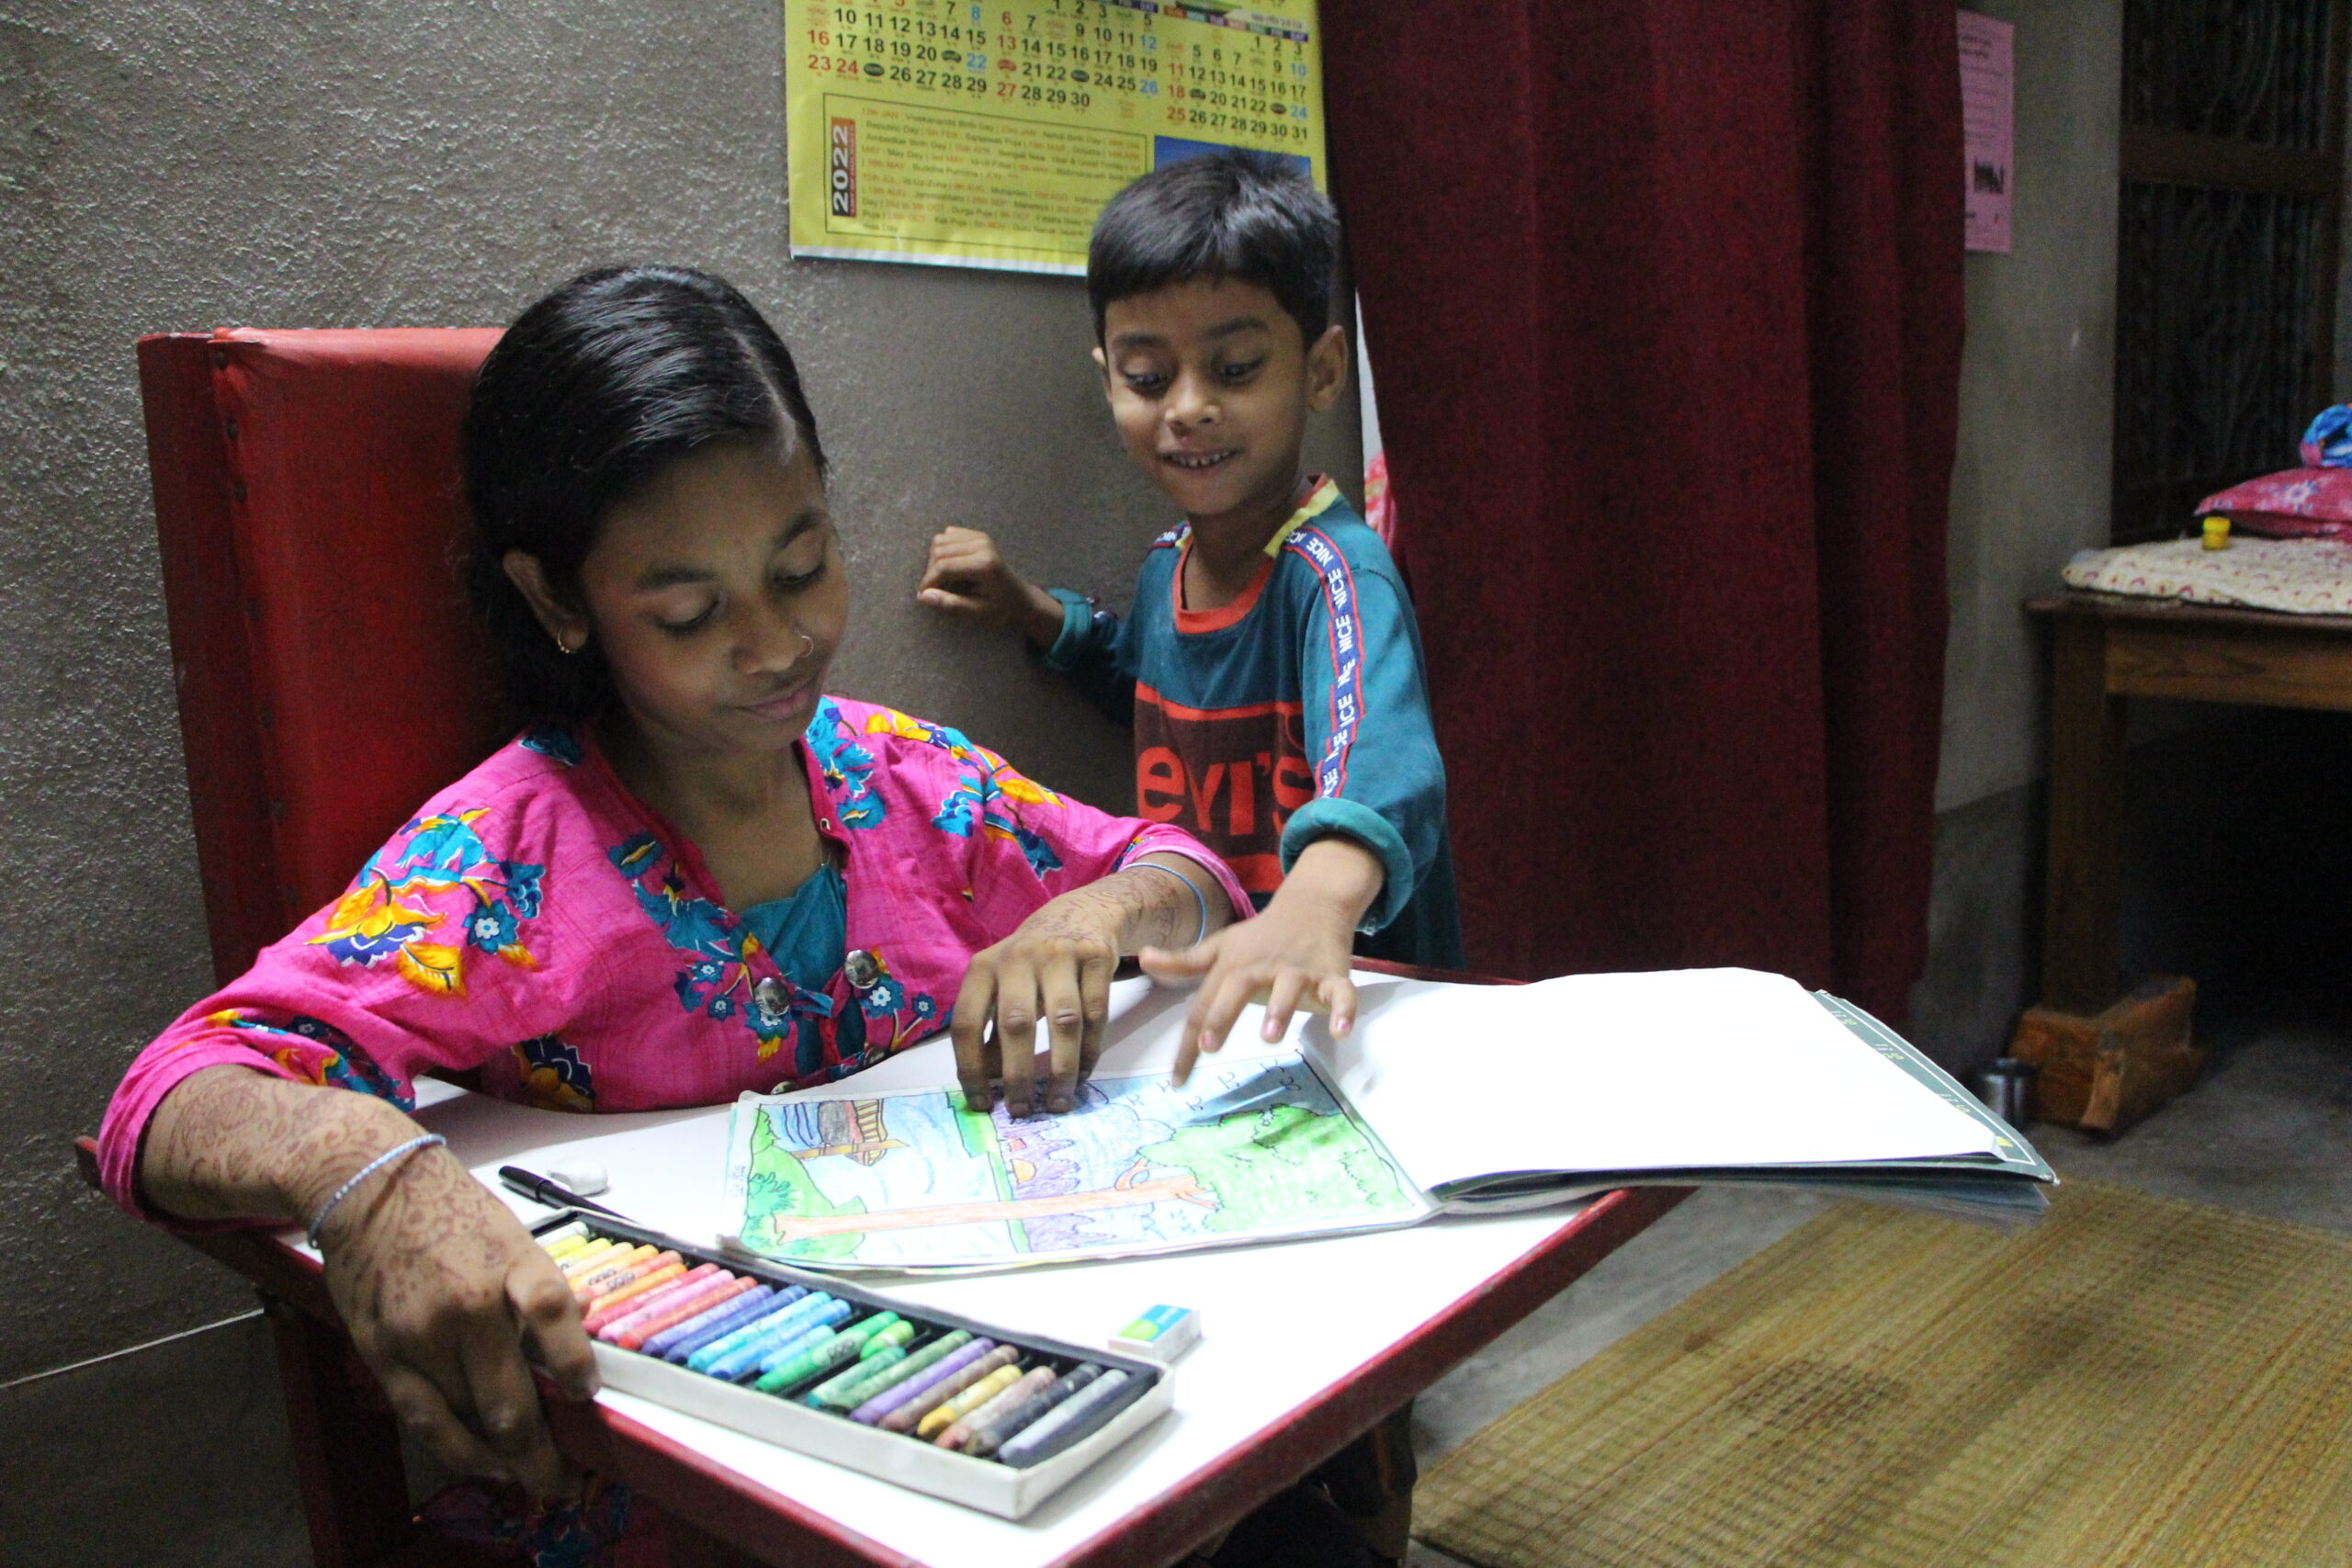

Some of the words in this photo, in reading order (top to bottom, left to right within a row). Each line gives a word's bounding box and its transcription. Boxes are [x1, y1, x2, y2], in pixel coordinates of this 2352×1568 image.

[946, 1, 956, 15] 7
[1076, 0, 1085, 14] 2
[1099, 4, 1106, 18] 3
[834, 7, 857, 24] 10
[864, 12, 883, 28] 11
[889, 16, 910, 32] 12
[916, 20, 936, 36] 13
[941, 25, 961, 40] 14
[966, 29, 986, 45] 15
[1001, 11, 1012, 26] 6
[1026, 15, 1036, 30] 7
[1075, 23, 1085, 37] 9
[1093, 27, 1112, 42] 10
[1119, 31, 1134, 47] 11
[1140, 35, 1157, 51] 12
[808, 29, 831, 46] 16
[835, 33, 857, 49] 17
[864, 37, 885, 53] 18
[889, 40, 911, 57] 19
[916, 44, 937, 61] 20
[966, 53, 987, 69] 22
[999, 35, 1016, 51] 13
[1022, 39, 1041, 53] 14
[1047, 42, 1066, 57] 15
[1071, 46, 1090, 61] 16
[1095, 50, 1112, 65] 17
[1118, 53, 1135, 69] 18
[1141, 57, 1158, 73] 19
[1255, 36, 1261, 49] 1
[1272, 39, 1282, 52] 2
[808, 54, 831, 71] 23
[836, 58, 858, 74] 24
[889, 65, 911, 82] 26
[916, 70, 936, 85] 27
[941, 73, 962, 89] 28
[967, 77, 987, 93] 29
[1023, 62, 1041, 77] 21
[1046, 65, 1067, 81] 22
[1094, 73, 1113, 87] 24
[1117, 76, 1136, 91] 25
[1169, 62, 1184, 76] 11
[1189, 66, 1205, 81] 12
[1210, 70, 1226, 85] 13
[1230, 73, 1246, 87] 14
[1250, 77, 1266, 92] 15
[1270, 81, 1286, 96] 16
[1290, 85, 1306, 97] 17
[1213, 48, 1222, 62] 6
[1233, 51, 1241, 65] 7
[1273, 60, 1282, 73] 9
[1291, 63, 1306, 77] 10
[997, 82, 1016, 97] 27
[1022, 85, 1042, 101] 28
[1046, 88, 1067, 104] 29
[1070, 92, 1091, 107] 30
[1168, 85, 1185, 99] 18
[1209, 91, 1227, 106] 20
[1231, 95, 1247, 109] 21
[1250, 98, 1266, 113] 22
[1291, 105, 1307, 118] 24
[1167, 107, 1186, 121] 25
[1189, 109, 1207, 124] 26
[1210, 113, 1227, 127] 27
[1230, 117, 1247, 131] 28
[1250, 120, 1267, 134] 29
[1270, 123, 1287, 138] 30
[1292, 126, 1307, 140] 31
[833, 125, 848, 213] 2022
[1306, 537, 1334, 567] NICE
[1328, 568, 1347, 611] NICE
[1335, 615, 1353, 654] NICE
